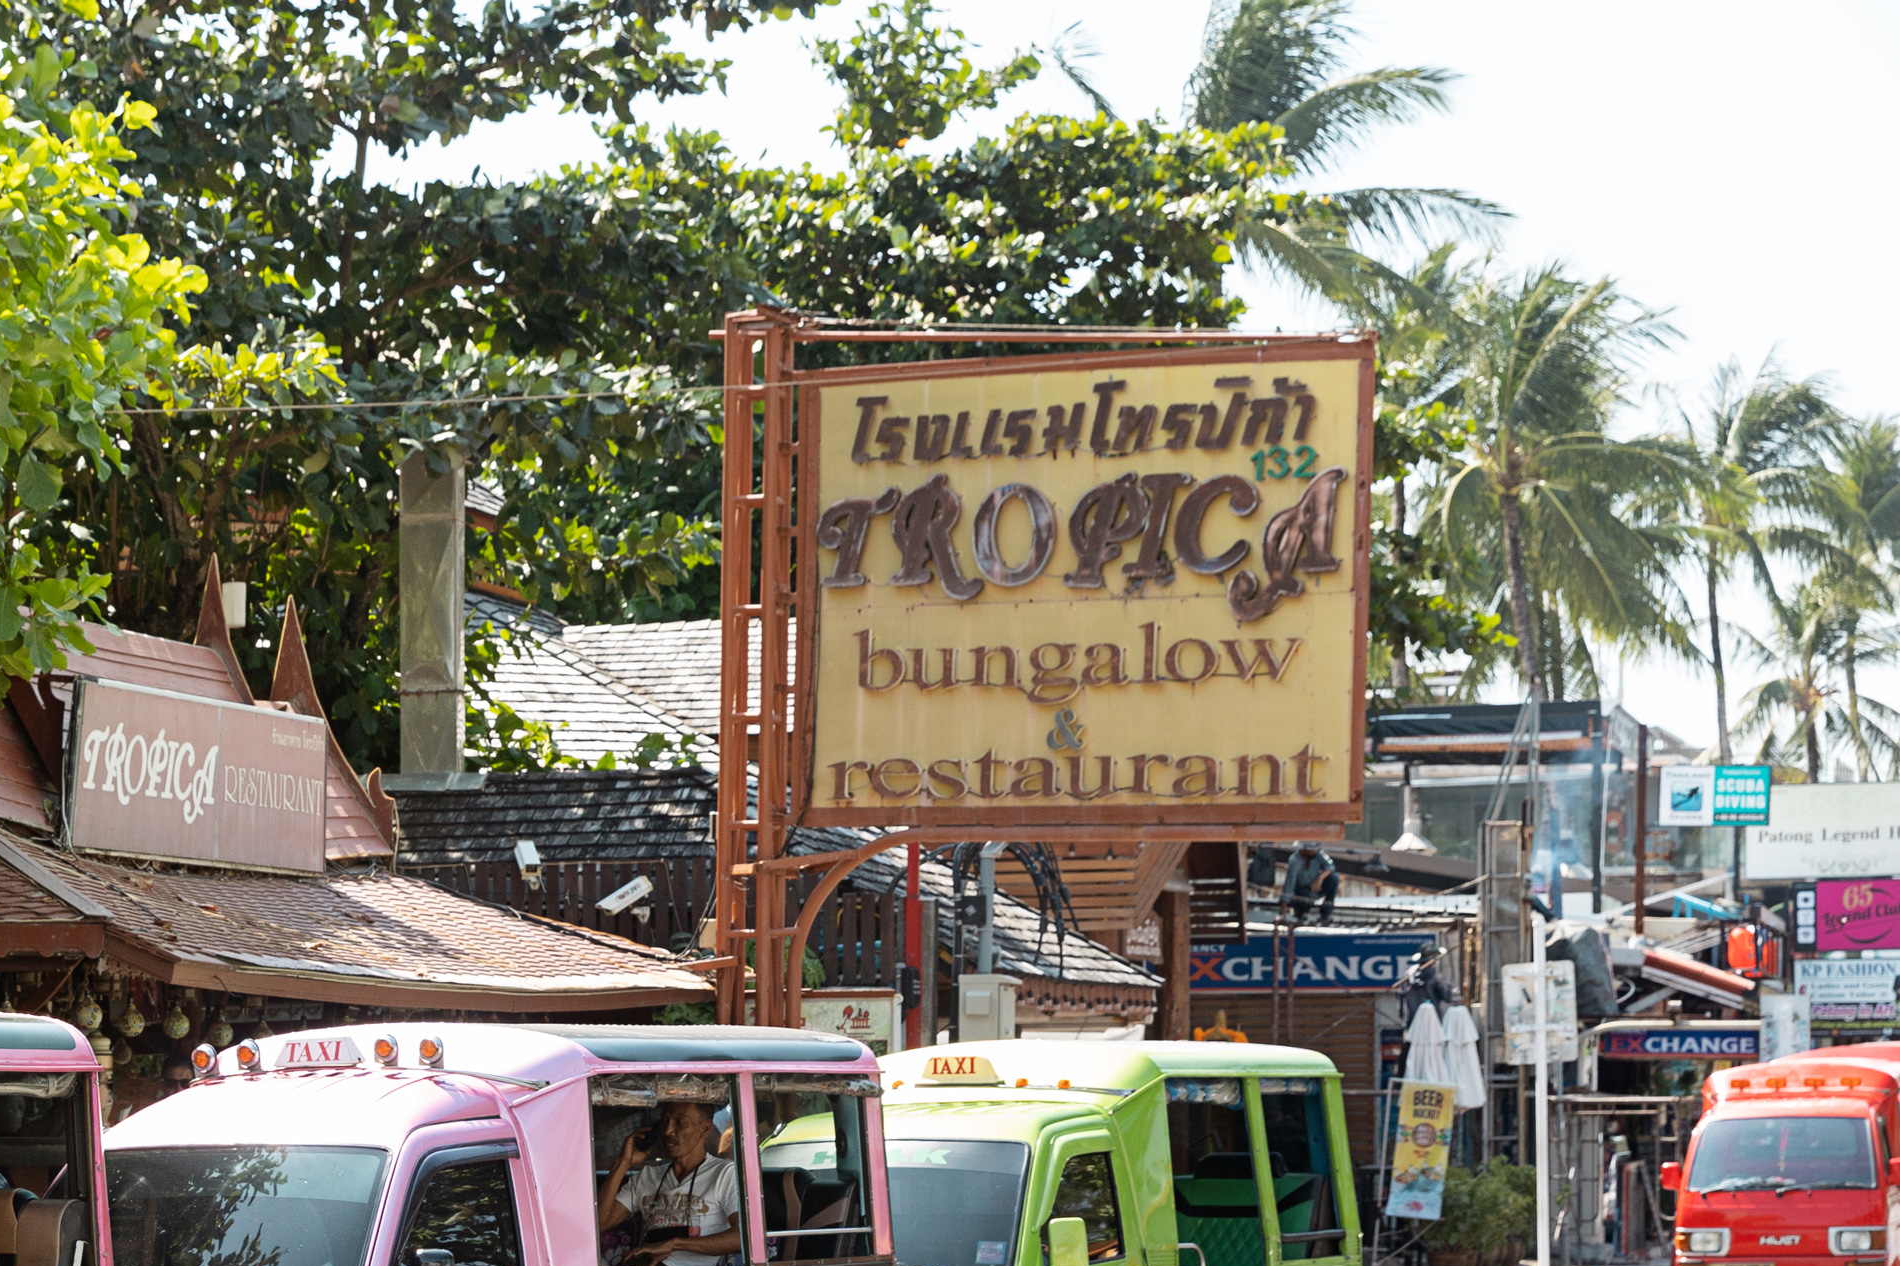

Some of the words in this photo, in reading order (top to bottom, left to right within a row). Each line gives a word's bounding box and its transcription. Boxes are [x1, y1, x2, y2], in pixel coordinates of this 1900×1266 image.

[1251, 446, 1318, 482] 132
[817, 466, 1349, 622] TROPICA
[853, 621, 1304, 705] bungalow
[1046, 708, 1087, 751] &
[83, 722, 219, 824] TROPICA
[827, 743, 1330, 802] restaurant
[224, 765, 324, 816] RESTAURANT
[1716, 778, 1766, 793] SCUBA
[1715, 794, 1767, 809] DIVING
[1758, 830, 1813, 844] Patong
[1822, 827, 1880, 843] Legend
[1843, 883, 1873, 910] 65
[1826, 963, 1896, 977] FASHION
[286, 1041, 342, 1062] TAXI
[1611, 1036, 1756, 1054] EXCHANGE
[929, 1056, 976, 1075] TAXI
[1413, 1090, 1444, 1108] BEER
[1759, 1235, 1801, 1246] HIJET
